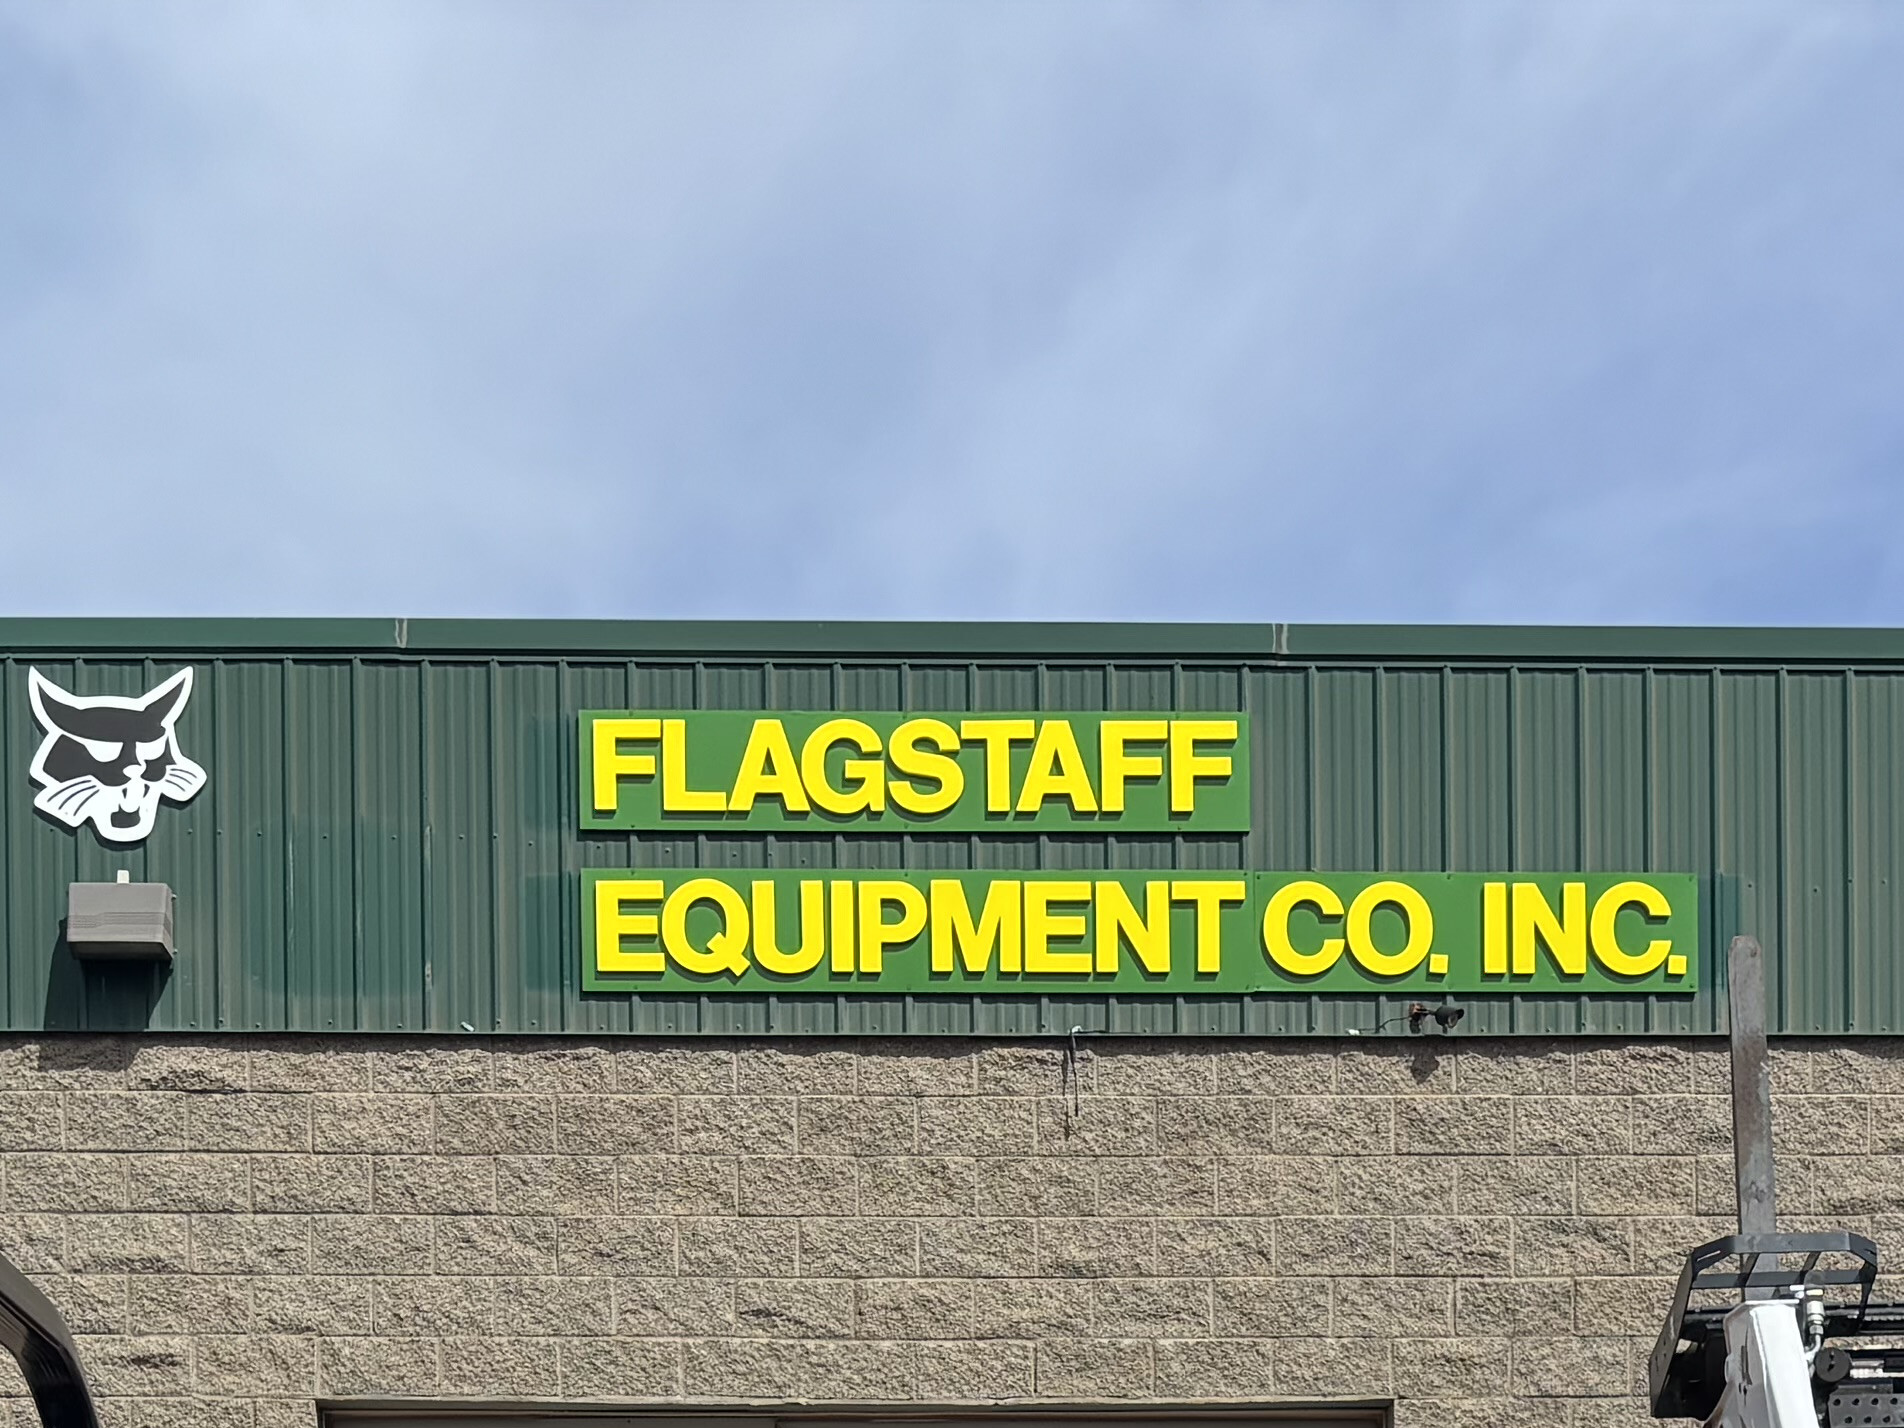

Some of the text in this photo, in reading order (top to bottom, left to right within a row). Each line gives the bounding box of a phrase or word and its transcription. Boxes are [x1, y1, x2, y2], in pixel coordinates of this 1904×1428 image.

[592, 718, 1237, 814] FLAGSTAFF
[594, 879, 1687, 982] EQUIPMENT CO. INC.
